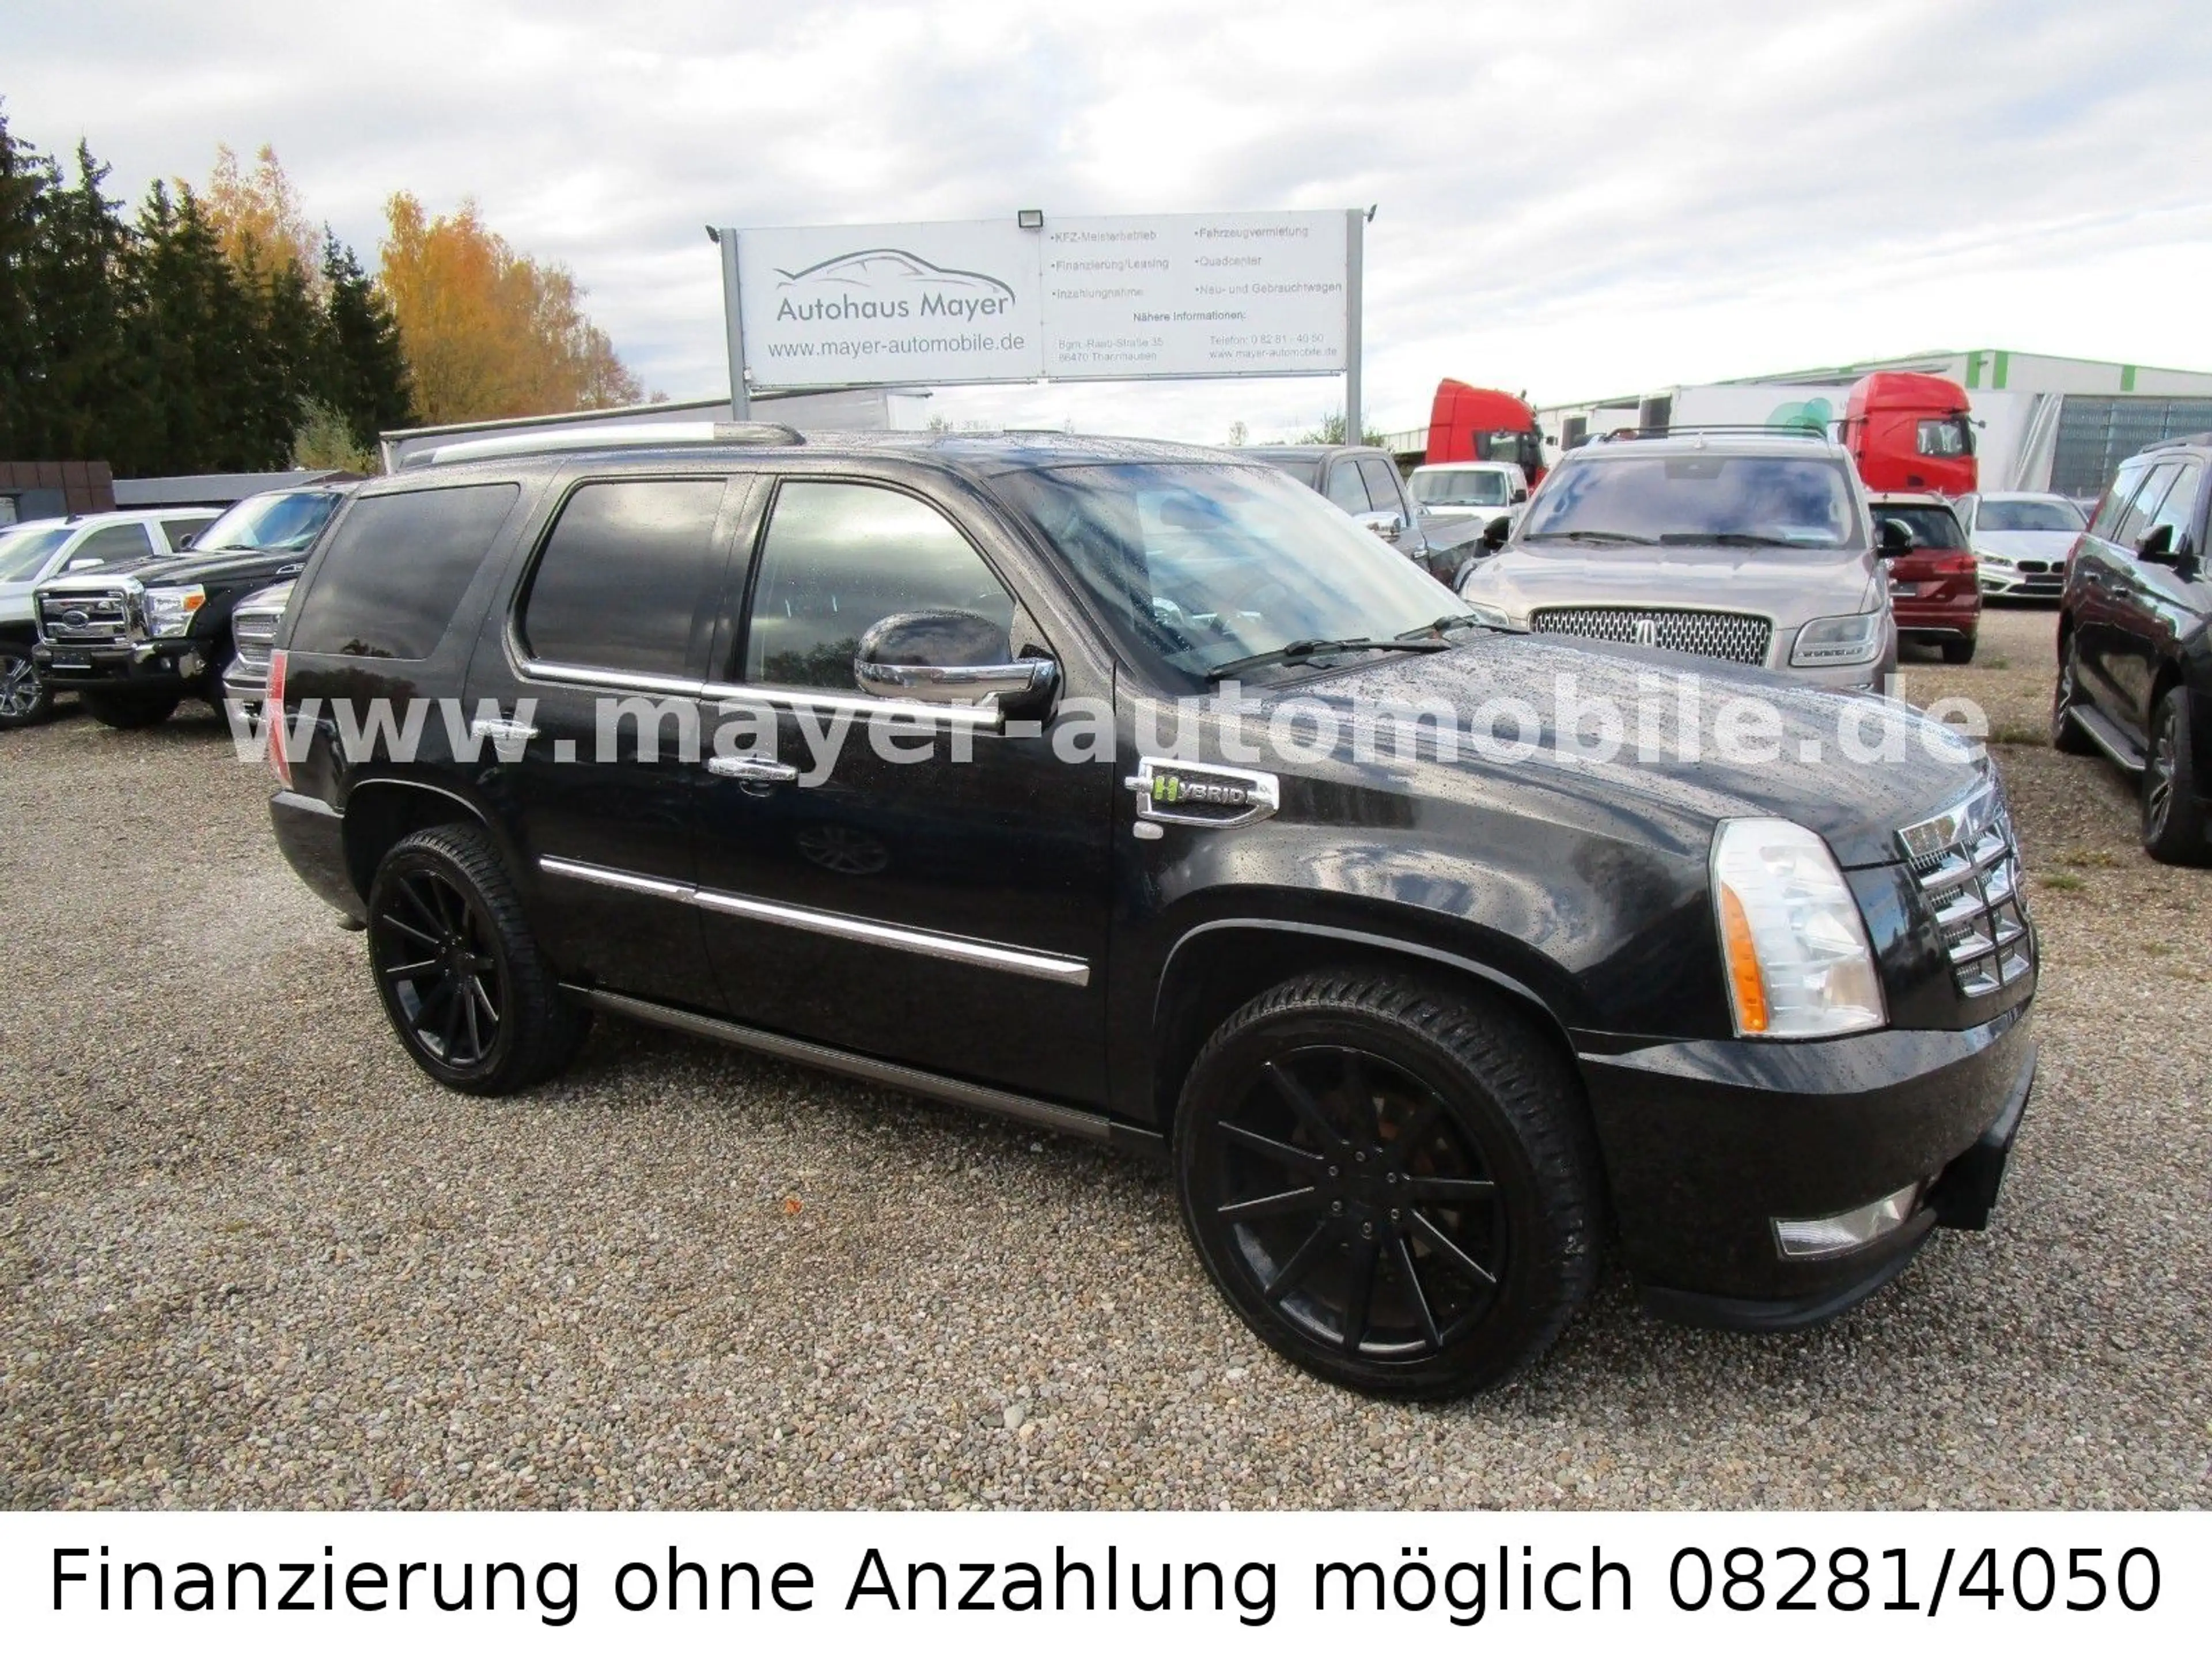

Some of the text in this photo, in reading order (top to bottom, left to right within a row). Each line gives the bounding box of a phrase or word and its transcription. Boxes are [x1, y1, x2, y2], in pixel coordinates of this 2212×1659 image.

[1055, 230, 1157, 243] KFZ-Meisterbetrieb
[1199, 226, 1309, 239] Fahrzeugvermietung
[1056, 258, 1169, 272] Finanzierung/Leasing
[1200, 256, 1262, 267] Quadcenter
[1229, 283, 1249, 294] und
[1252, 282, 1342, 294] Gebrauchtwagen
[777, 292, 1009, 323] Autohaus Mayer
[1132, 310, 1247, 322] Nähere Informationen:
[767, 333, 1025, 359] www.mayer-automobile.de
[1209, 335, 1248, 345] Telefon:
[1154, 775, 1248, 805] HYBRID
